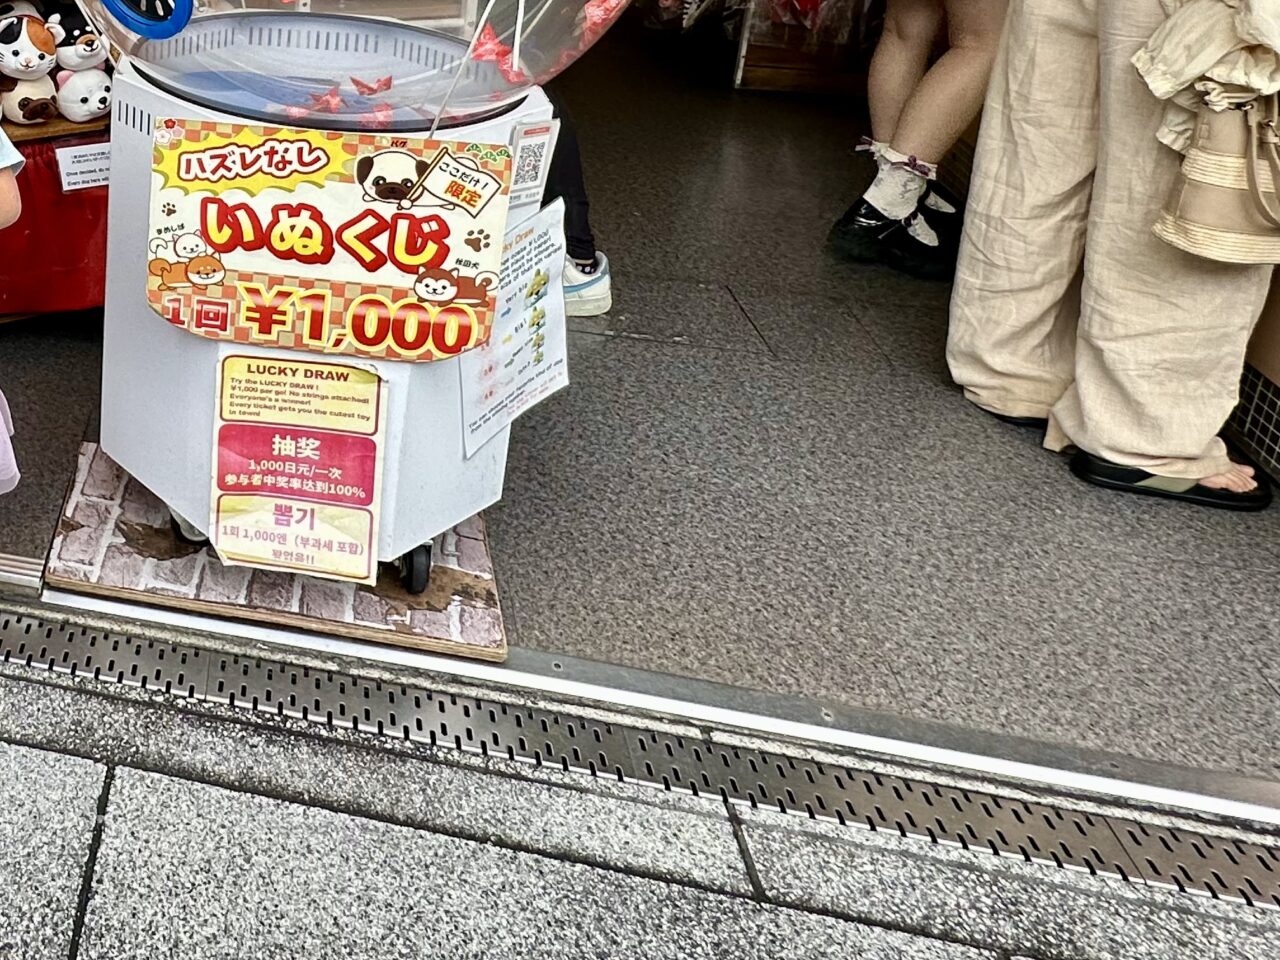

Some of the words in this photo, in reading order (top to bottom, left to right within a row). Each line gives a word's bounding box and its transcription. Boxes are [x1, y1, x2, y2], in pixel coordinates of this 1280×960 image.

[181, 143, 326, 179] ハズレなし
[444, 181, 482, 209] 限定
[203, 200, 447, 270] いぬくじ
[166, 297, 229, 333] 1回
[239, 285, 474, 356] ¥1,000
[230, 377, 242, 385] Try
[247, 363, 300, 378] LUCKY
[303, 368, 350, 382] DRAW
[230, 393, 272, 403] Everyone's
[281, 397, 311, 406] winner!
[260, 388, 272, 396] per
[302, 392, 330, 401] strings
[331, 394, 369, 405] attached!
[230, 401, 251, 409] Every
[253, 402, 276, 411] ticket
[278, 404, 296, 413] gets
[298, 406, 312, 415] you
[314, 407, 327, 415] the
[329, 409, 355, 418] cutest
[357, 413, 370, 422] toy
[271, 434, 321, 459] 抽奖
[248, 459, 343, 480] 1,000日元/一次
[224, 474, 366, 498] 参与者中奖率达到100%
[272, 503, 315, 531] 뽑기
[222, 525, 239, 538] 1회
[243, 528, 287, 546] 1,000엔
[336, 540, 364, 556] 포함)
